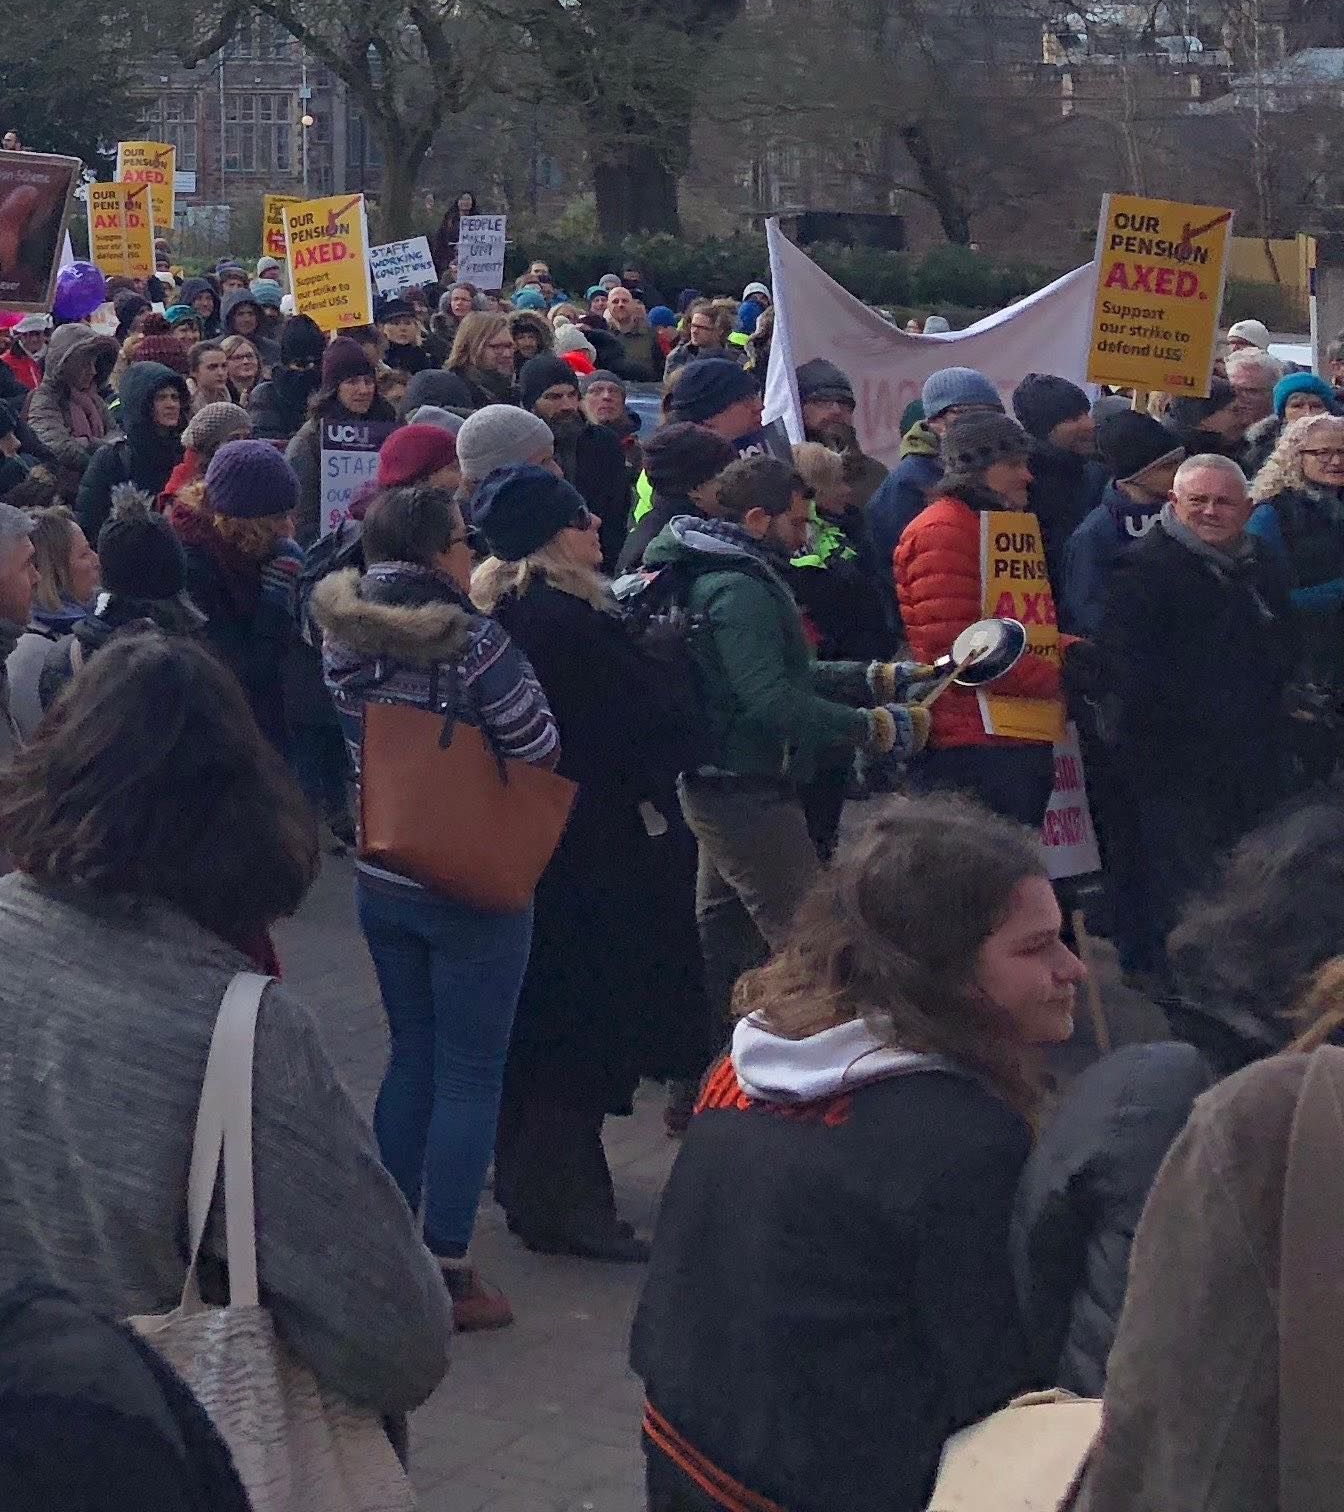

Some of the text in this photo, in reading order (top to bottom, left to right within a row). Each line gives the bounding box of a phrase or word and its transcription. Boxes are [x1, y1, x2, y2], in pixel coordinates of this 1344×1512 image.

[123, 158, 168, 168] PENSION
[123, 170, 168, 185] AXED.
[93, 191, 116, 199] OUR
[94, 201, 142, 210] PENSON
[95, 215, 145, 228] AXD.
[290, 213, 314, 228] OUR
[462, 218, 502, 231] PEOPLE
[1114, 213, 1160, 234] OUR
[291, 223, 349, 244] PENSION
[294, 241, 355, 269] AXED.
[371, 242, 409, 258] STAFF
[1110, 235, 1208, 264] PENSION
[372, 251, 423, 268] WORKING
[375, 261, 432, 279] CONDITIONS
[1104, 263, 1208, 300] AXED.
[329, 295, 348, 306] USS
[1102, 301, 1165, 320] Support
[1100, 322, 1190, 342] our strike to
[1098, 340, 1151, 357] defend
[327, 456, 376, 477] STAF
[995, 533, 1037, 554] OUR
[994, 559, 1047, 580] PENS
[995, 591, 1058, 626] AXE
